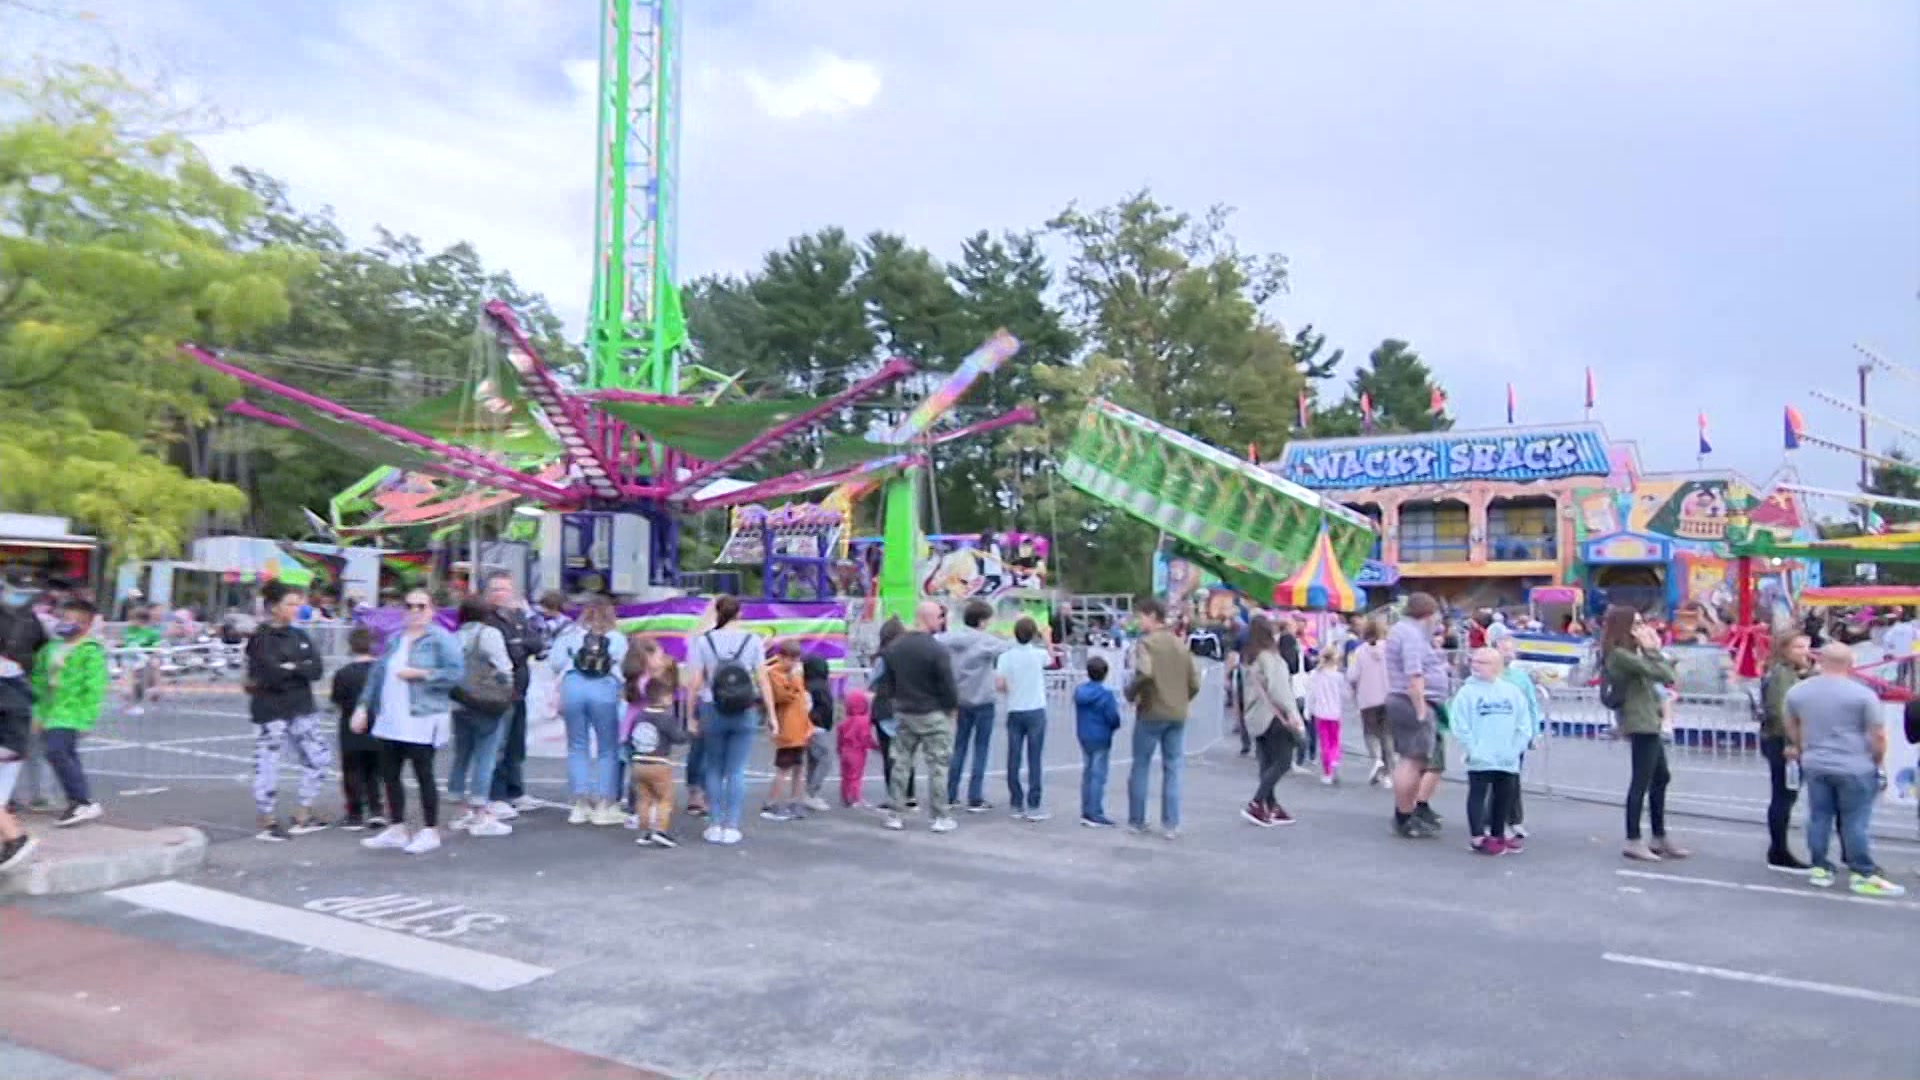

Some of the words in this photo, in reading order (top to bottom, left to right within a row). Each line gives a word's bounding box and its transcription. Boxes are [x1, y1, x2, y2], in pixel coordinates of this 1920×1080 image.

[1304, 446, 1438, 480] WACKY
[1450, 437, 1579, 474] SHACK
[303, 894, 508, 938] STOP
